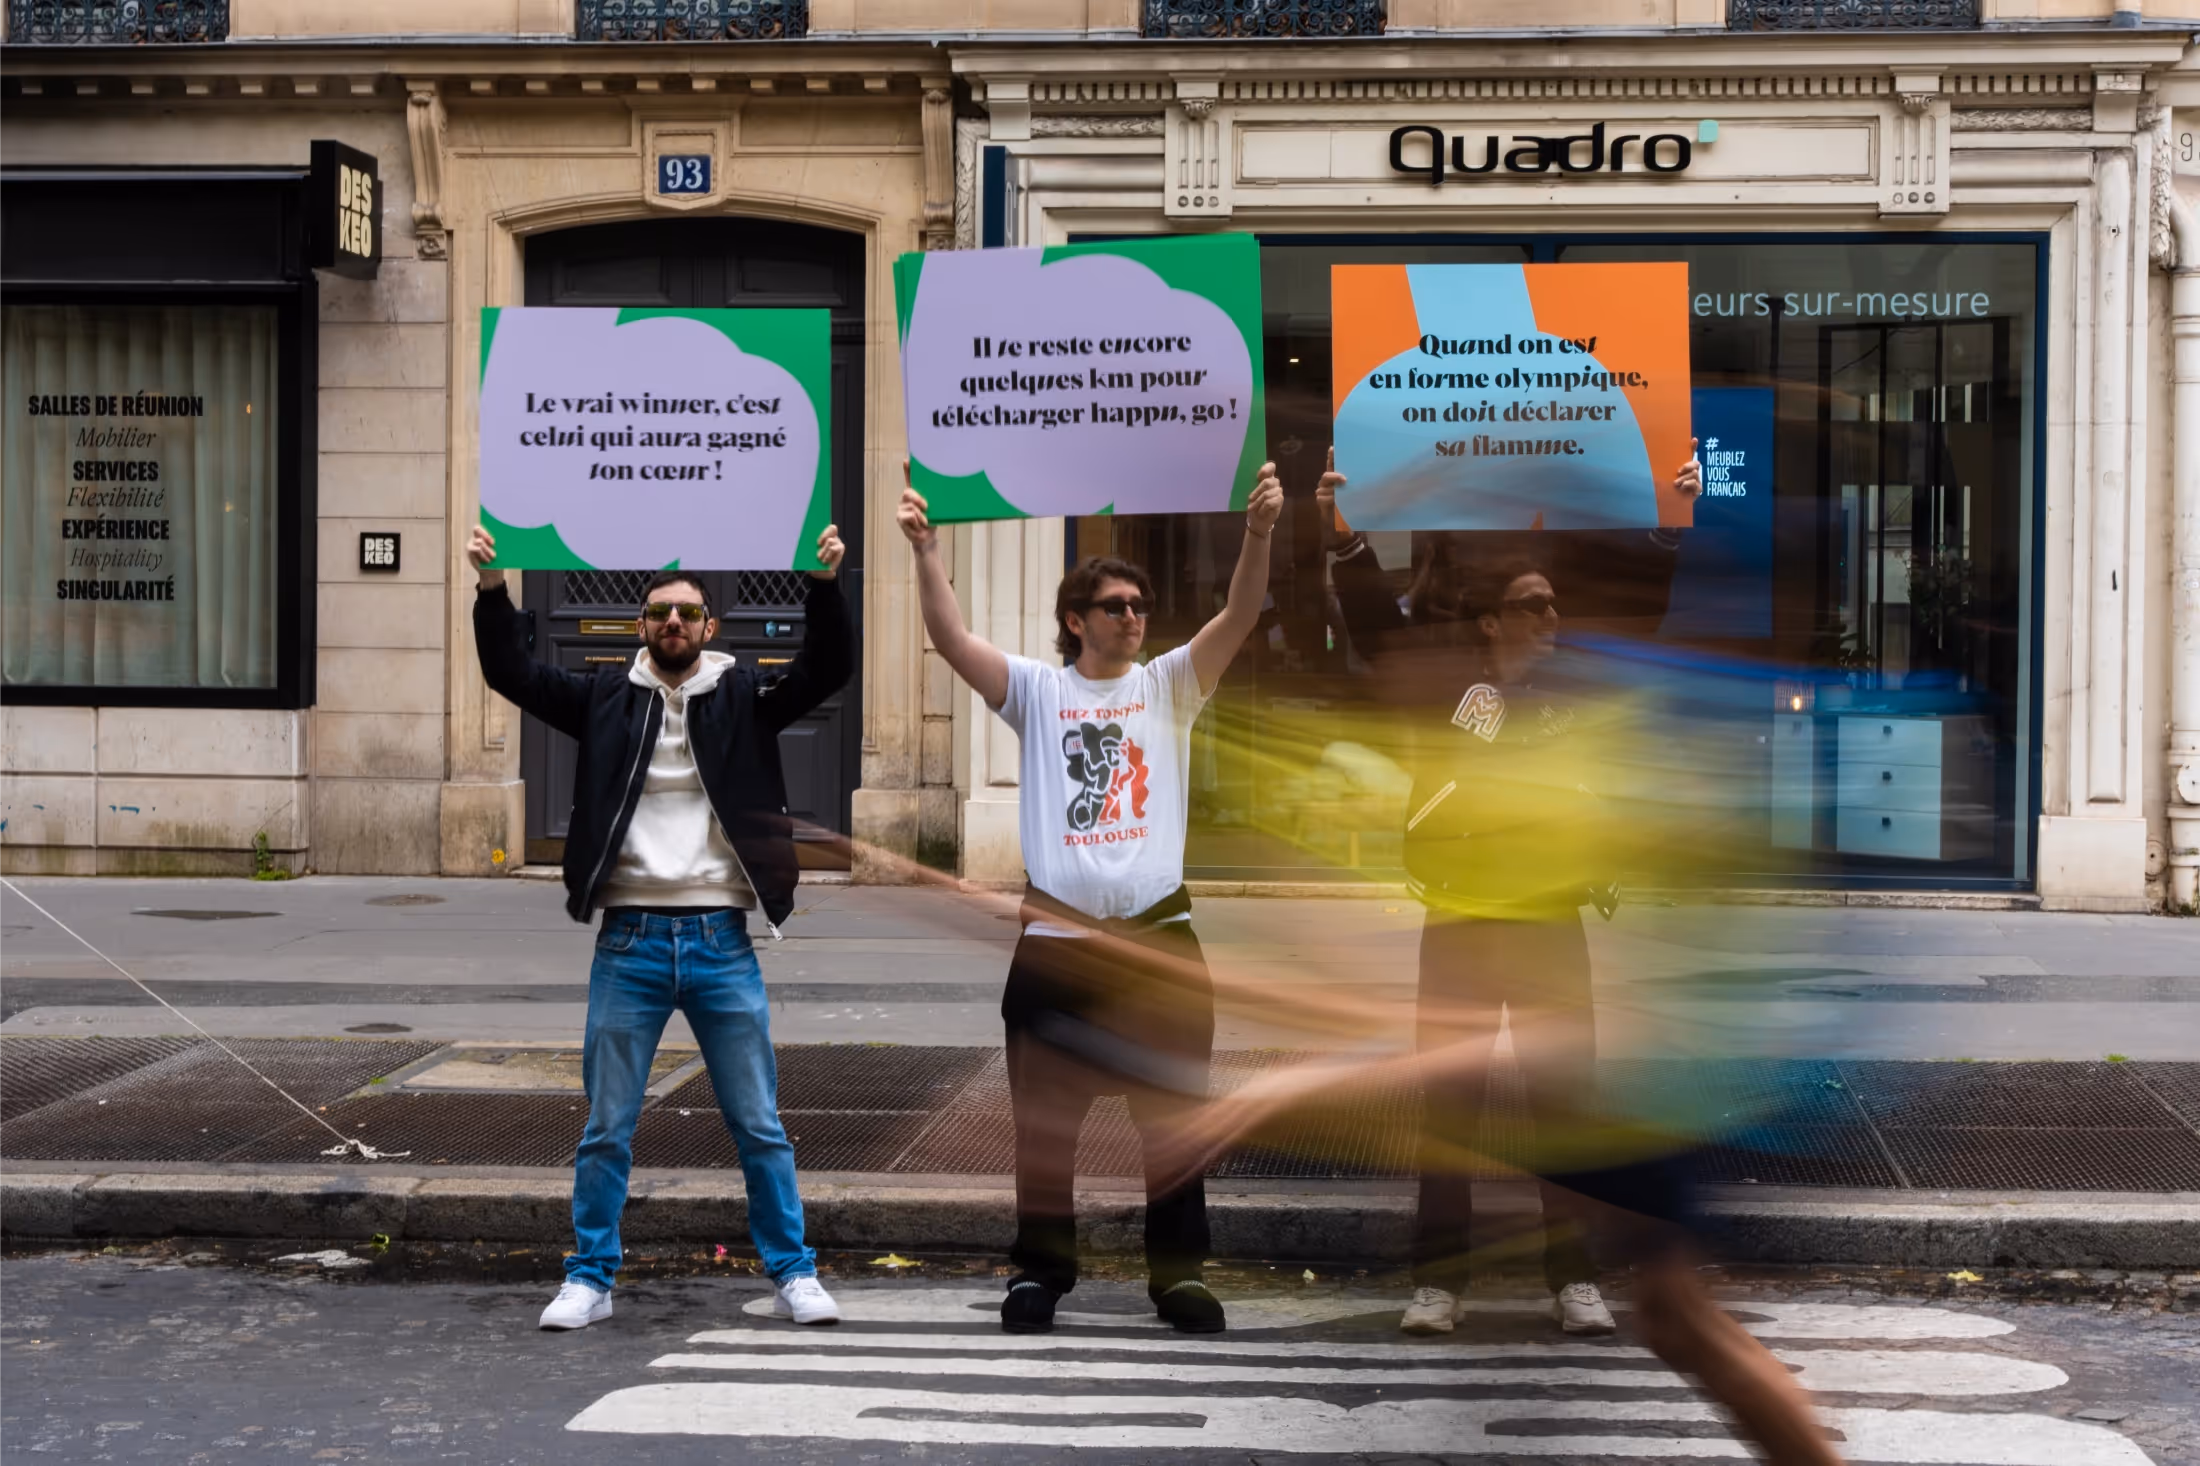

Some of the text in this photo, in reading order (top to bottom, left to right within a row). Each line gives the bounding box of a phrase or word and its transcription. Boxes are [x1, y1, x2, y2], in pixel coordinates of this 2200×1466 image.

[2180, 132, 2200, 162] 9
[666, 158, 703, 189] 93
[340, 164, 372, 216] DES
[340, 207, 372, 258] KEO
[1688, 291, 1990, 317] eurs sur-mesure
[973, 332, 1193, 358] Il te reste encore
[1418, 333, 1598, 358] Quand on est
[960, 368, 1208, 397] quelques km pour
[1369, 365, 1649, 392] en forme olympique,
[28, 390, 204, 417] SALLES DE RÉUNION
[525, 391, 781, 417] Le vrai winner, c'est
[932, 402, 1086, 431] télécharger
[1090, 401, 1187, 426] happn,
[1191, 404, 1225, 426] go
[1402, 400, 1617, 423] on doit déclarer
[75, 427, 157, 449] Mobilier
[520, 425, 787, 451] celui qui aura gagné
[1435, 435, 1585, 457] sa flamme.
[73, 460, 159, 481] SERVICES
[589, 461, 634, 480] ton
[639, 464, 710, 480] cœur
[1706, 451, 1745, 466] MEUBLEZ
[1706, 467, 1730, 481] VOUS
[66, 486, 165, 508] Flexibilité
[1706, 481, 1747, 497] FRANÇAIS
[62, 514, 170, 540] EXPÉRIENCE
[364, 538, 395, 551] DES
[70, 548, 163, 573] Hospitality
[364, 551, 395, 565] KEO
[57, 575, 175, 601] SINGULARITÉ
[1059, 708, 1090, 720] CHZ
[1063, 826, 1149, 847] TOULOUSE
